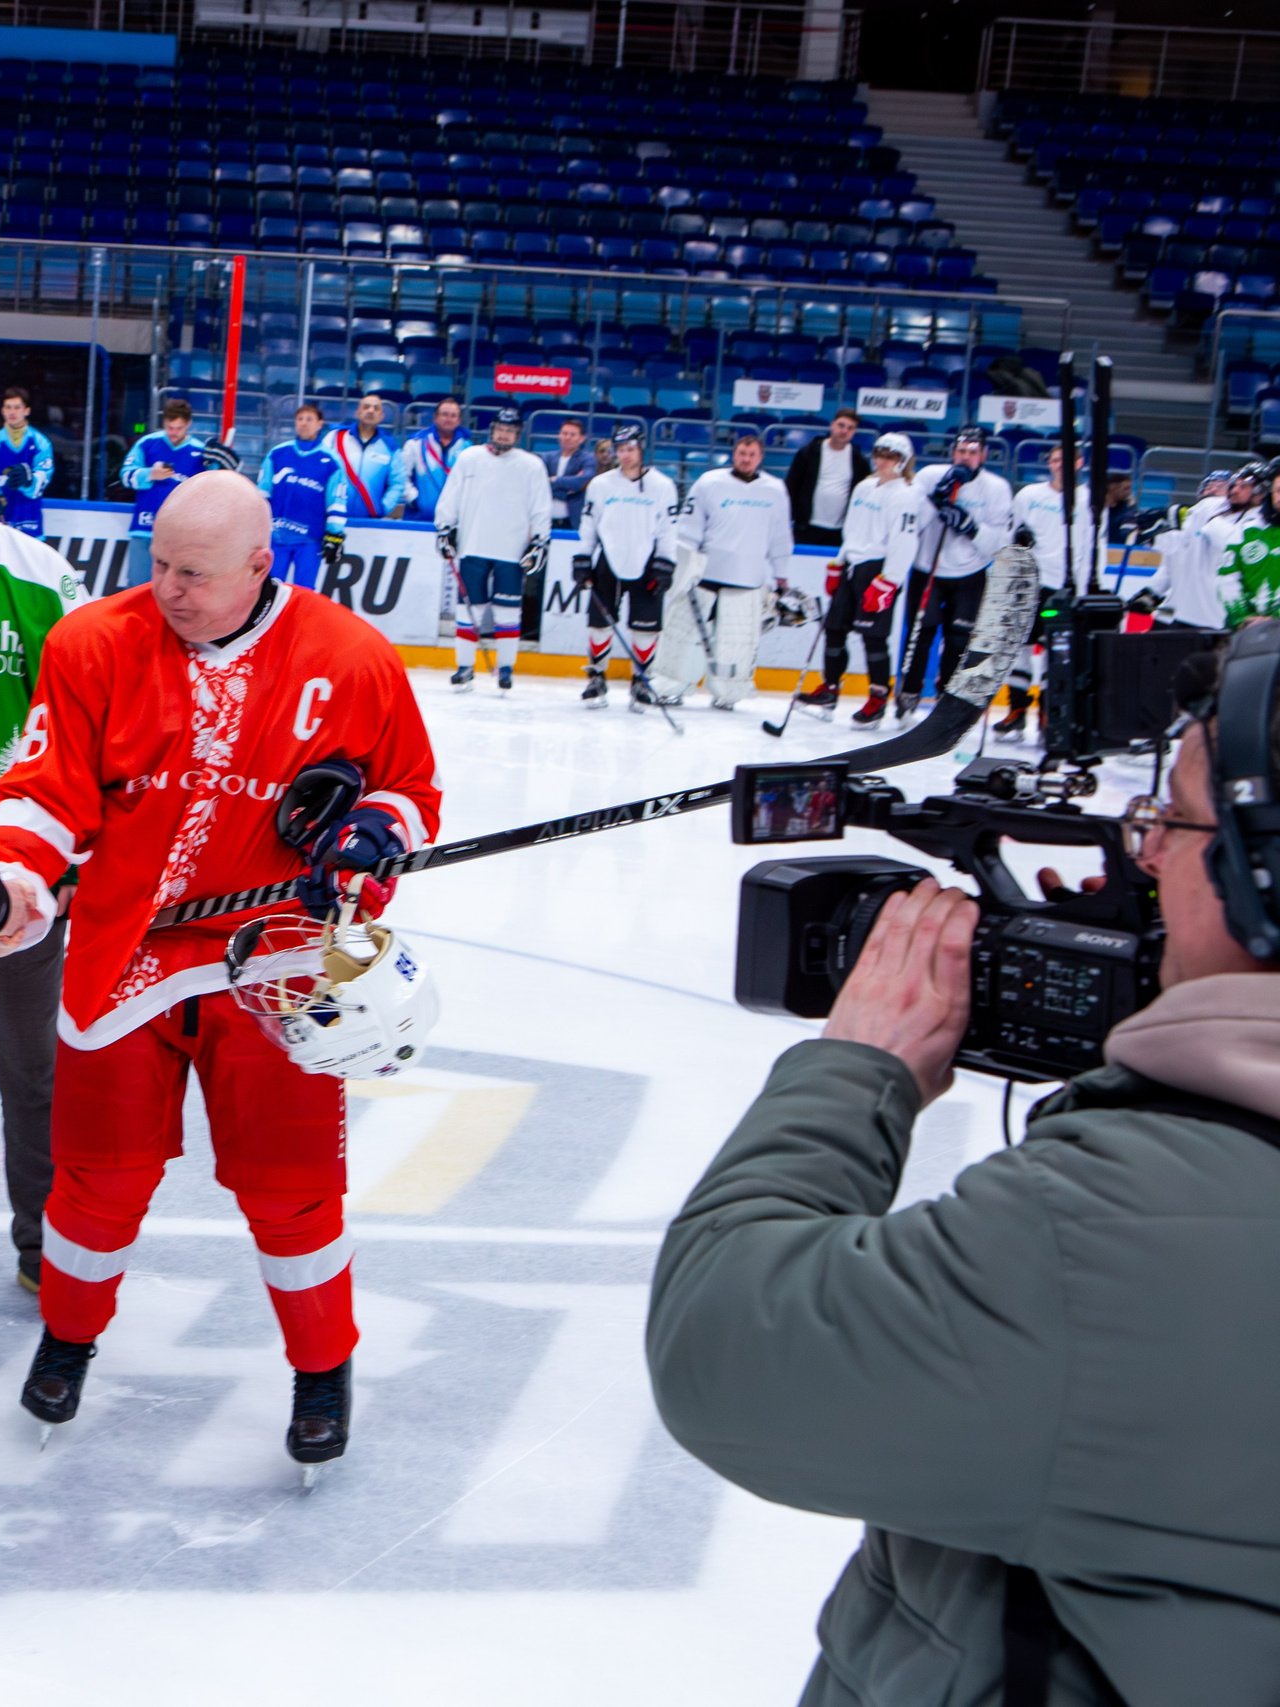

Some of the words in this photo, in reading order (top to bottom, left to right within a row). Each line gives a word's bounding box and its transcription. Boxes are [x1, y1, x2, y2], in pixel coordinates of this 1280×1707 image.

[497, 373, 568, 388] OLIMPBET
[292, 677, 333, 741] C
[1233, 779, 1256, 805] 2
[1074, 931, 1130, 949] SONY
